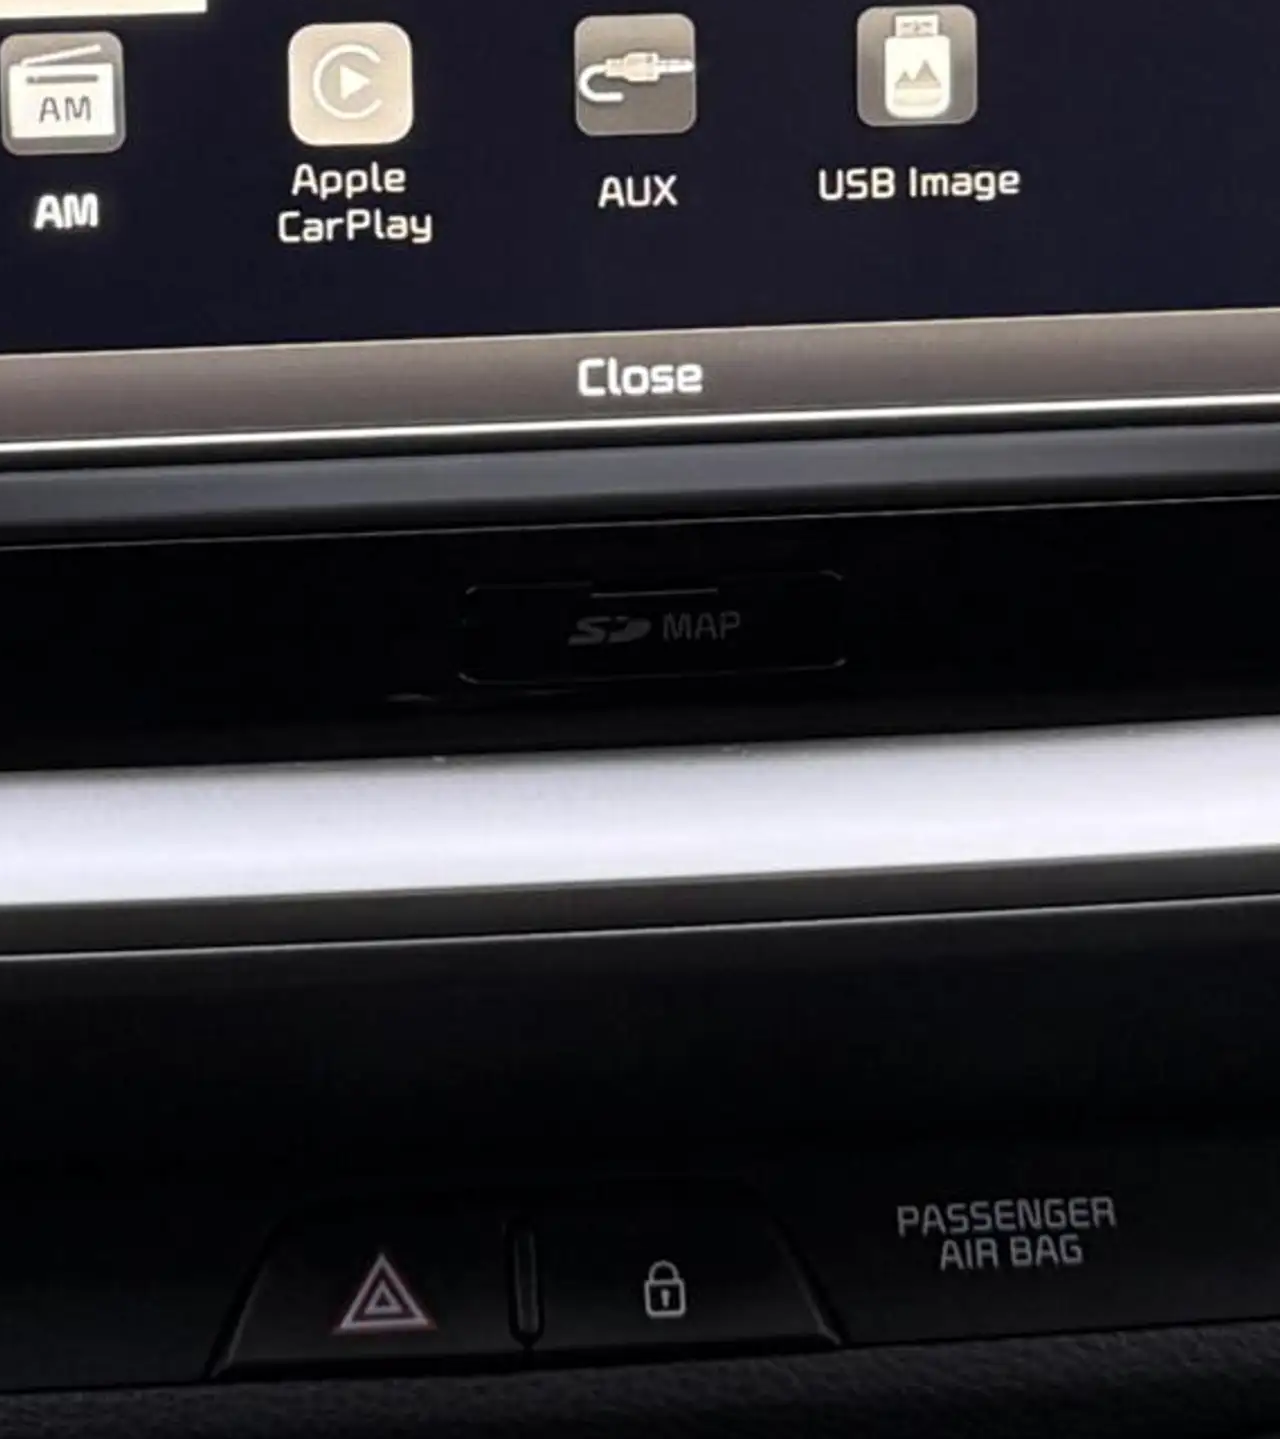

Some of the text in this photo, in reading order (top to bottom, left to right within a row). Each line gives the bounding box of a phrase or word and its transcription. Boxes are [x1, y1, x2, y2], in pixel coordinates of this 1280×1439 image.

[38, 95, 92, 123] AM
[291, 162, 407, 201] Apple
[597, 175, 678, 208] AUX
[818, 166, 1021, 203] USB Image
[33, 193, 100, 231] AM
[277, 208, 434, 246] CarPlay
[577, 358, 703, 398] Close
[663, 610, 742, 642] MAP
[897, 1197, 1116, 1237] PASSENGER
[940, 1234, 1083, 1270] AIR BAG
